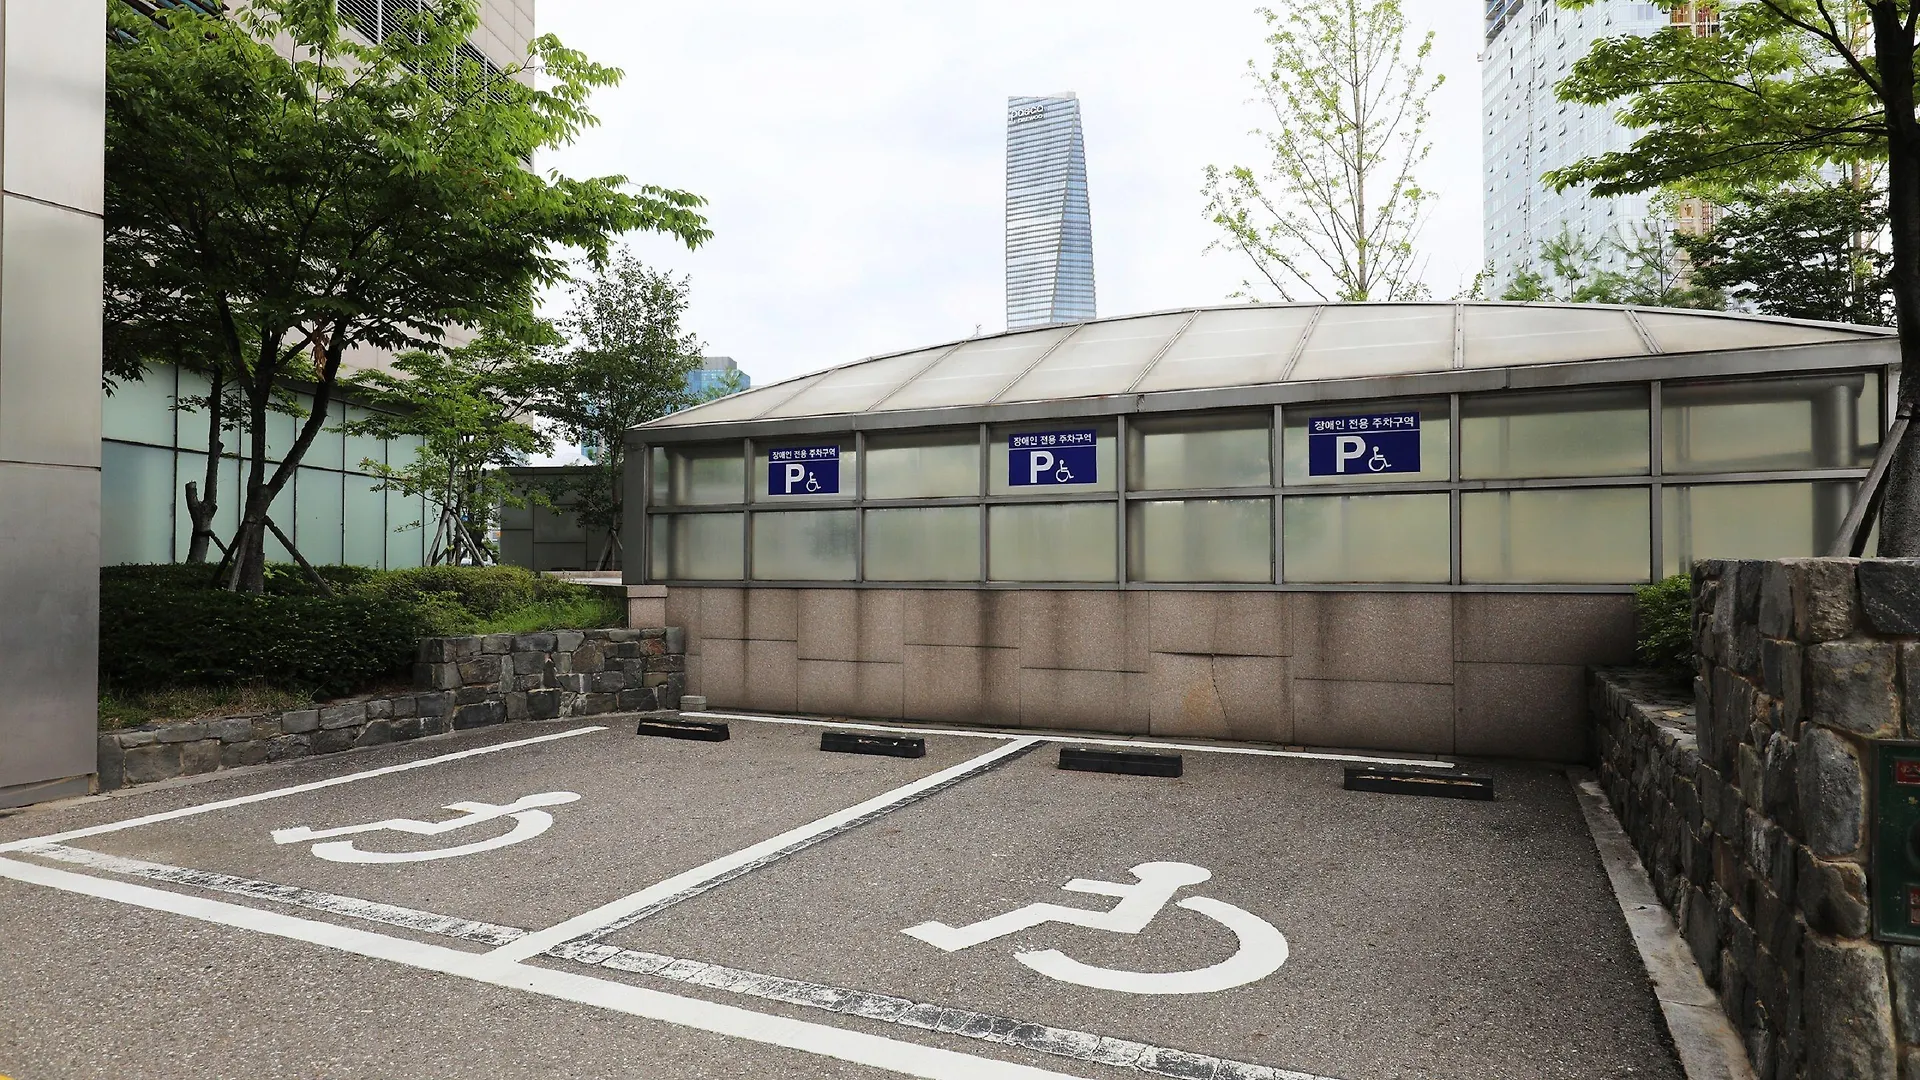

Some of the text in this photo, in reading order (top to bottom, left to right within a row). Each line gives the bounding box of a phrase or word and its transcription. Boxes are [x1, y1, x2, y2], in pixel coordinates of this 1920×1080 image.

[1314, 416, 1414, 431] 장애인 전용 주차구역
[1013, 433, 1092, 447] 장애인 전용 주차구역
[772, 447, 836, 460] 장애인 전용 주차구역
[1336, 435, 1366, 473] P
[785, 463, 805, 493] P
[1030, 450, 1055, 484] P
